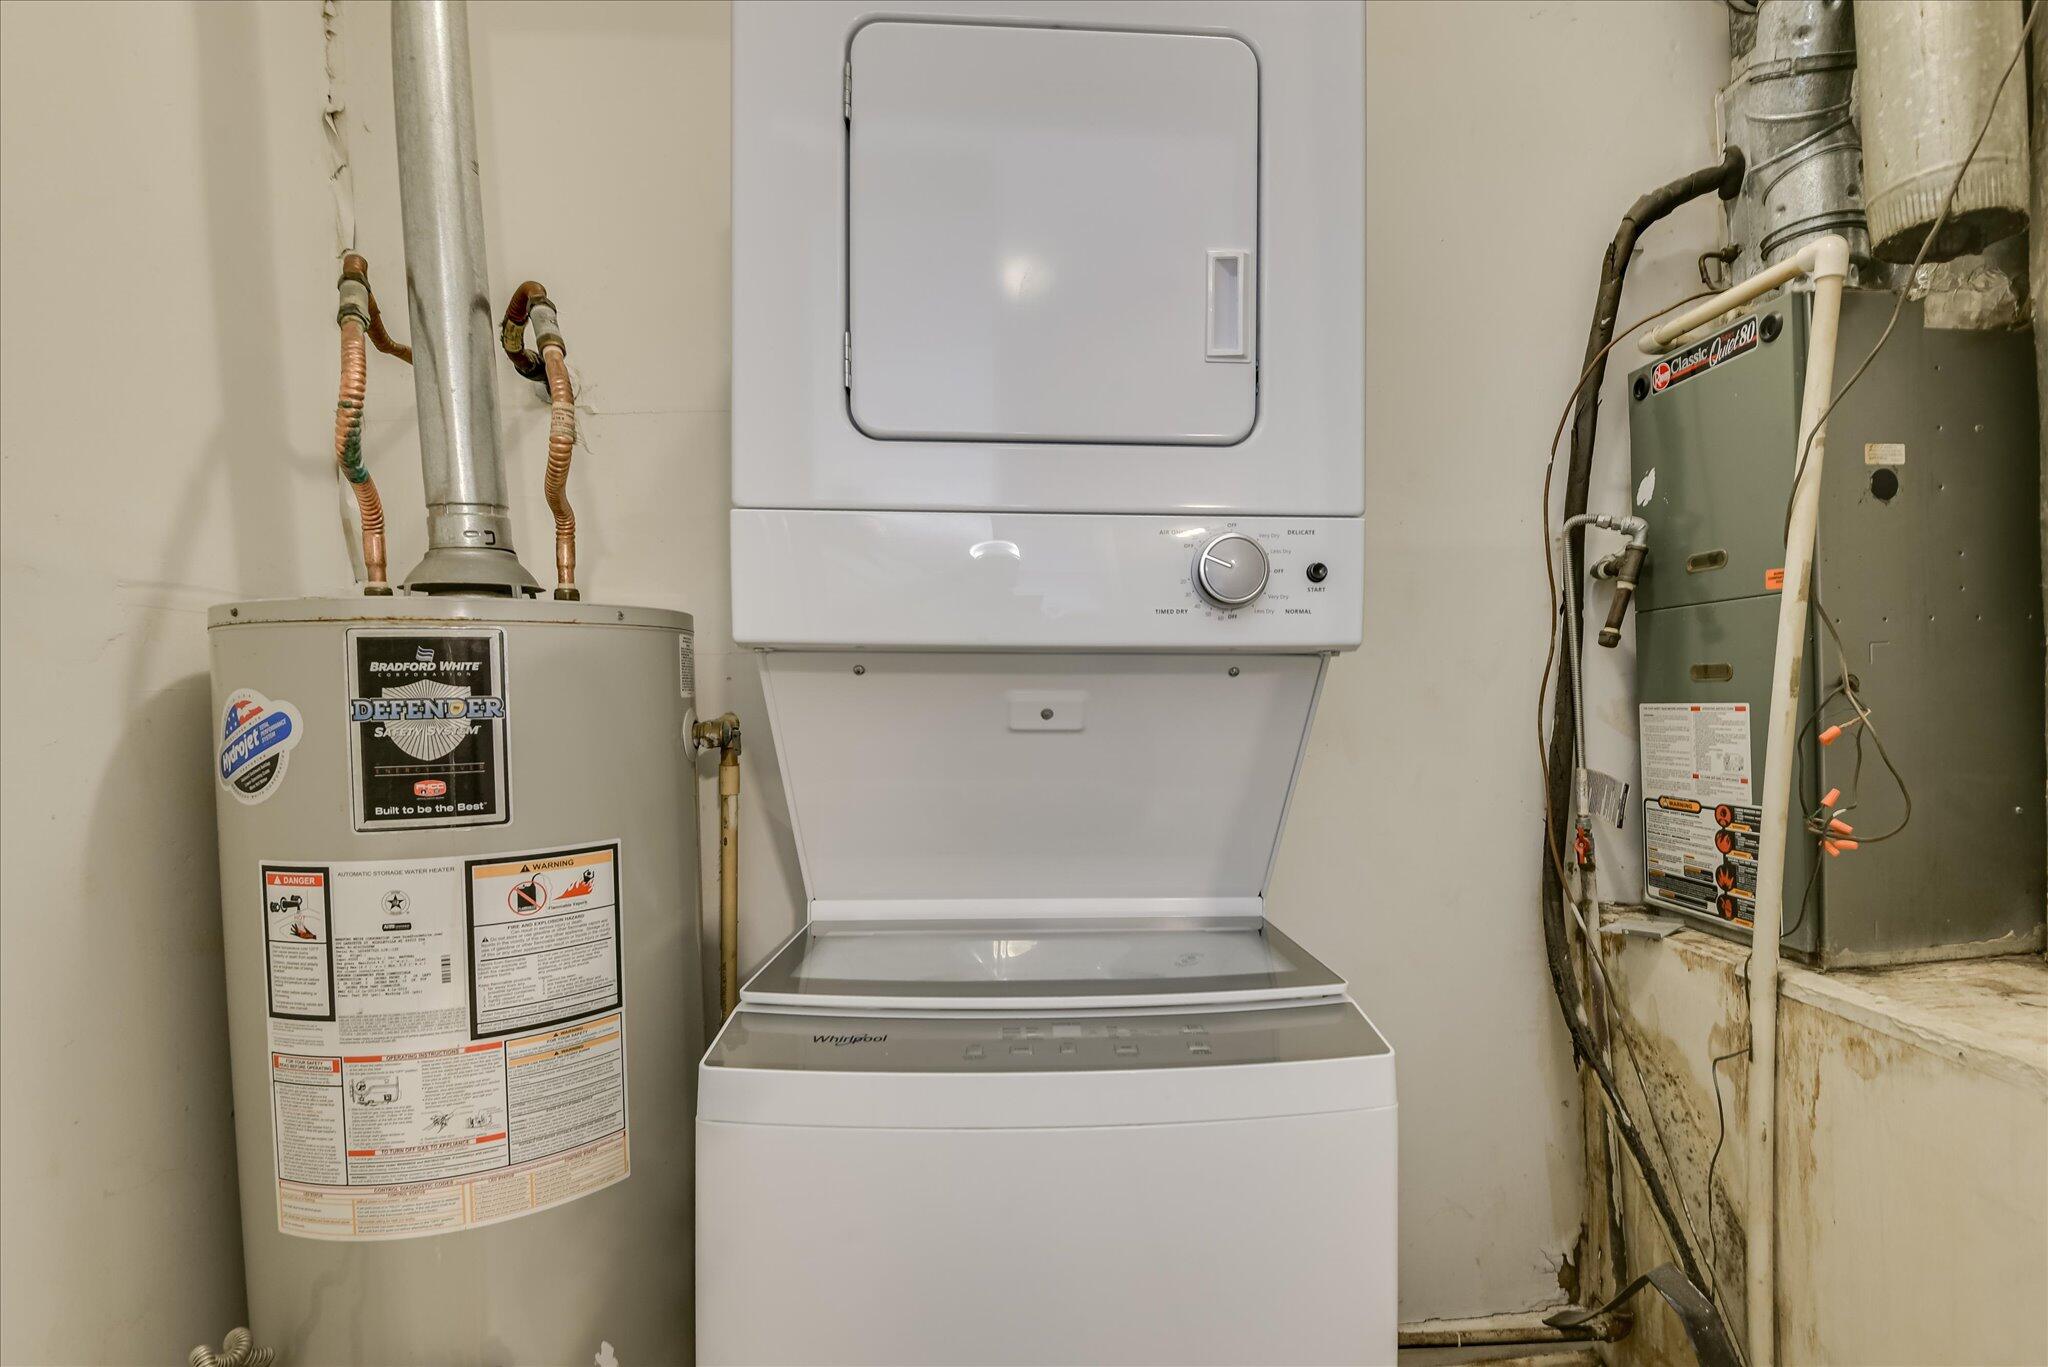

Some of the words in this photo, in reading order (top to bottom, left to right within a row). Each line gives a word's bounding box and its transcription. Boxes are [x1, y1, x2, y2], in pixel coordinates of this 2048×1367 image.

[1671, 347, 1708, 374] Classic
[369, 661, 437, 673] BRADFORD
[439, 661, 480, 672] WHITE
[351, 697, 505, 722] DEFENDER
[222, 728, 261, 772] Hydrojet
[375, 805, 400, 816] Built
[402, 806, 414, 815] to
[417, 804, 432, 814] be
[434, 803, 454, 813] the
[457, 802, 485, 812] Best
[532, 859, 575, 871] WARNING
[283, 876, 316, 885] DANGER
[521, 921, 534, 929] AND
[533, 917, 564, 927] EXPLOSION
[564, 913, 585, 922] HAZARD
[813, 1034, 888, 1047] Whirlpool
[386, 1052, 418, 1061] OPERATING
[418, 1048, 460, 1059] INSTRUCTIONS
